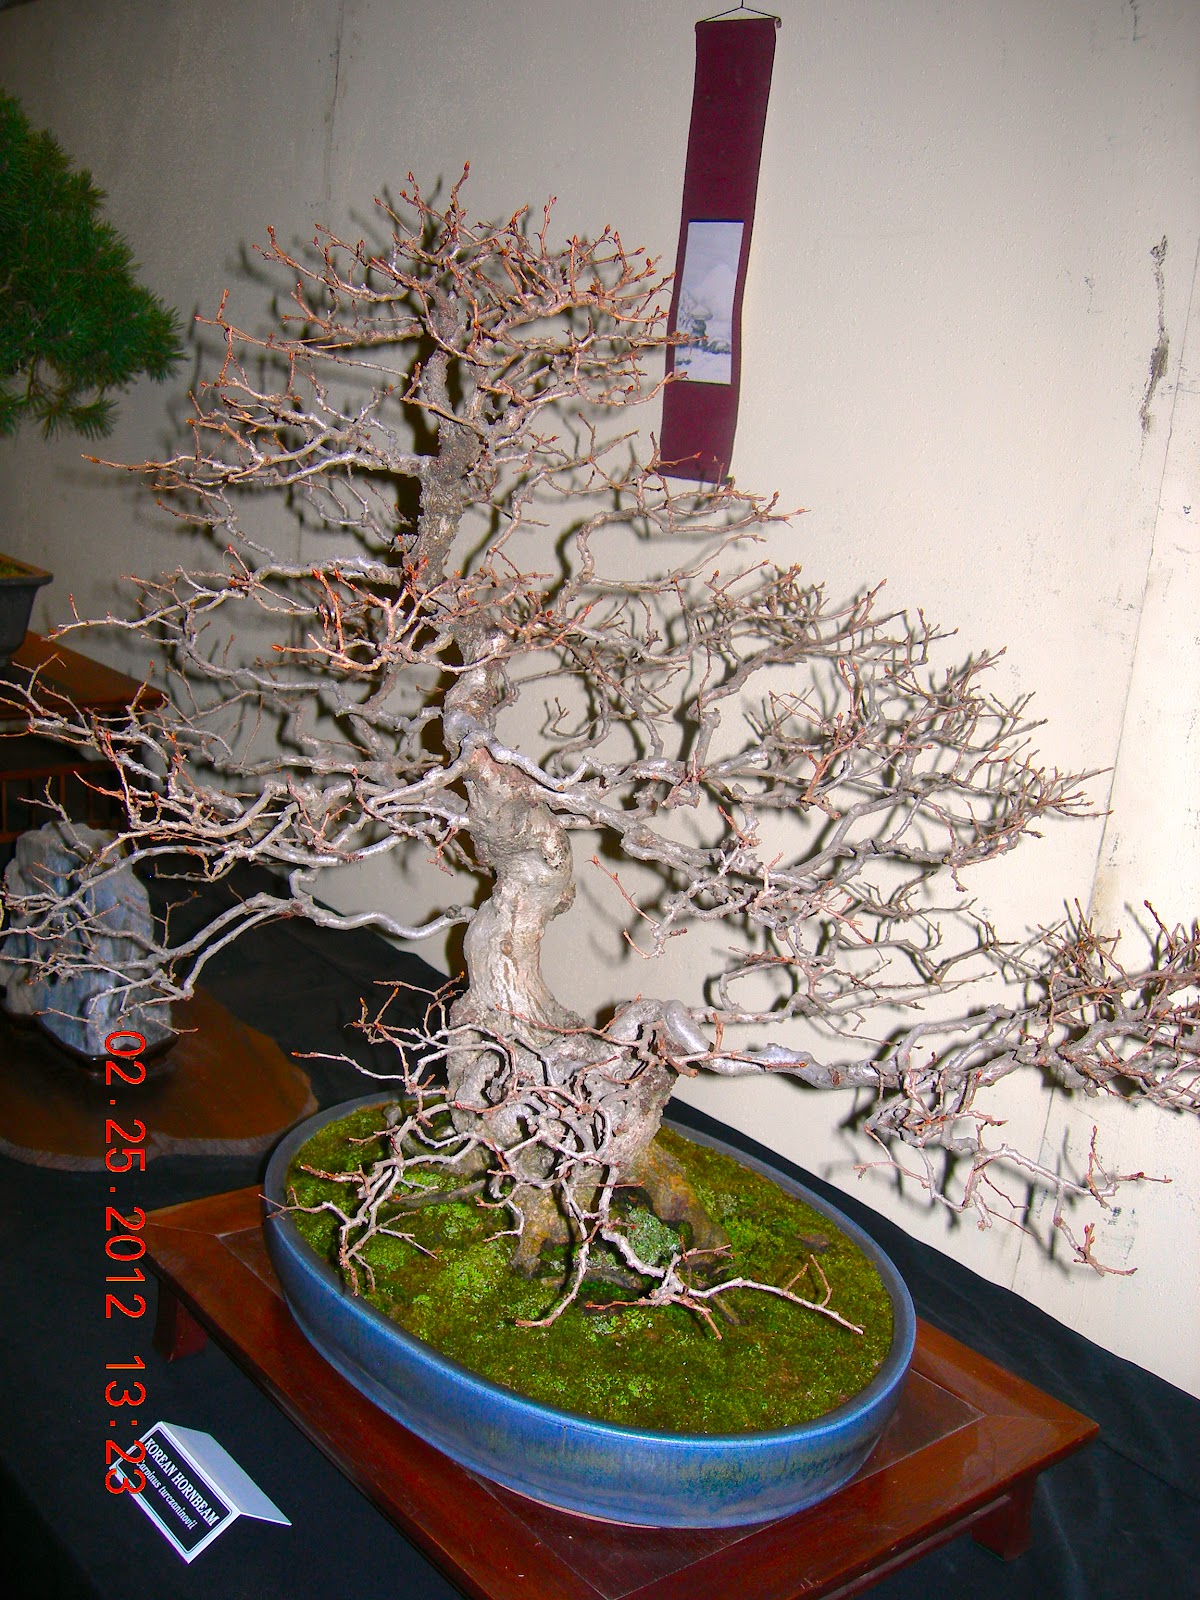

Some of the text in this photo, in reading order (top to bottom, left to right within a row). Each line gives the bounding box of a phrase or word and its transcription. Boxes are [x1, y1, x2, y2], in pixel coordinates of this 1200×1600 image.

[144, 1438, 220, 1526] KOREAN HORNBEAM
[158, 1484, 198, 1530] turczaninovii
